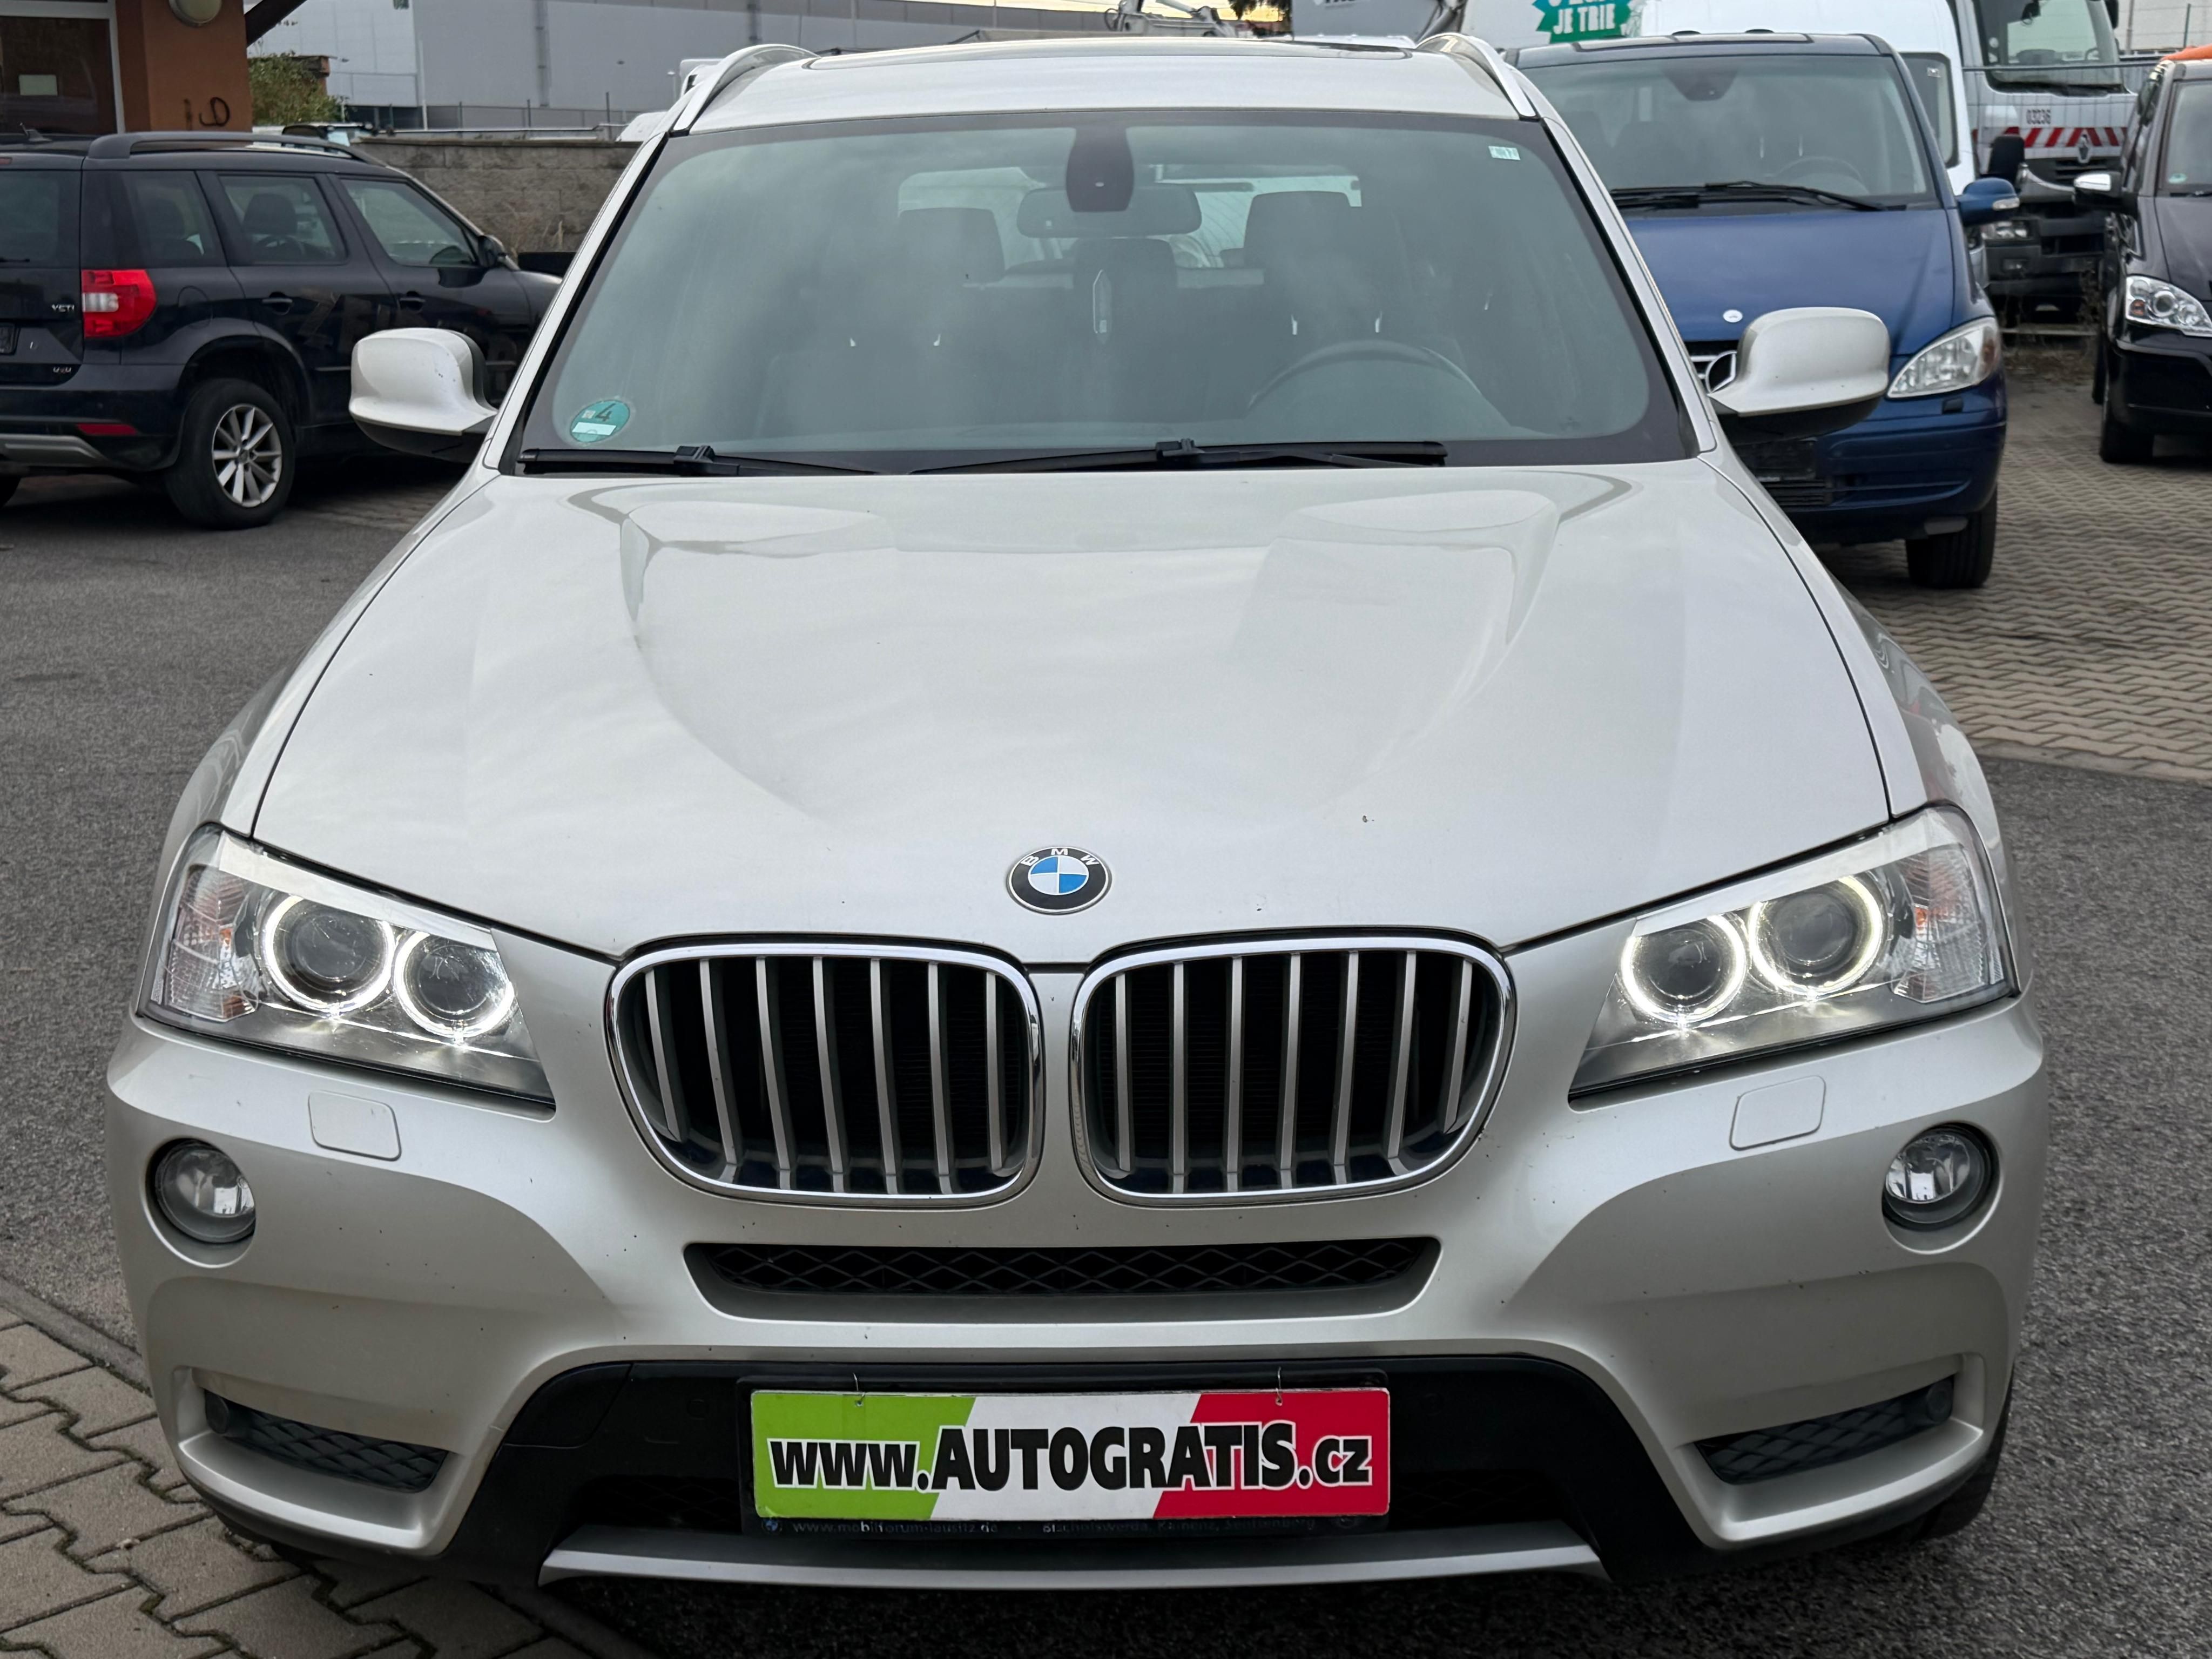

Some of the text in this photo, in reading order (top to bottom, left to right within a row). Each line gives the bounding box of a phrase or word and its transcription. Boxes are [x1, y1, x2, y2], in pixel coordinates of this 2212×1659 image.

[1553, 3, 1616, 35] JE TRIE
[52, 304, 75, 313] YETI
[595, 403, 616, 422] 4
[1021, 848, 1100, 866] BMW
[767, 1420, 1373, 1492] www.AUTOGRATIS.cz
